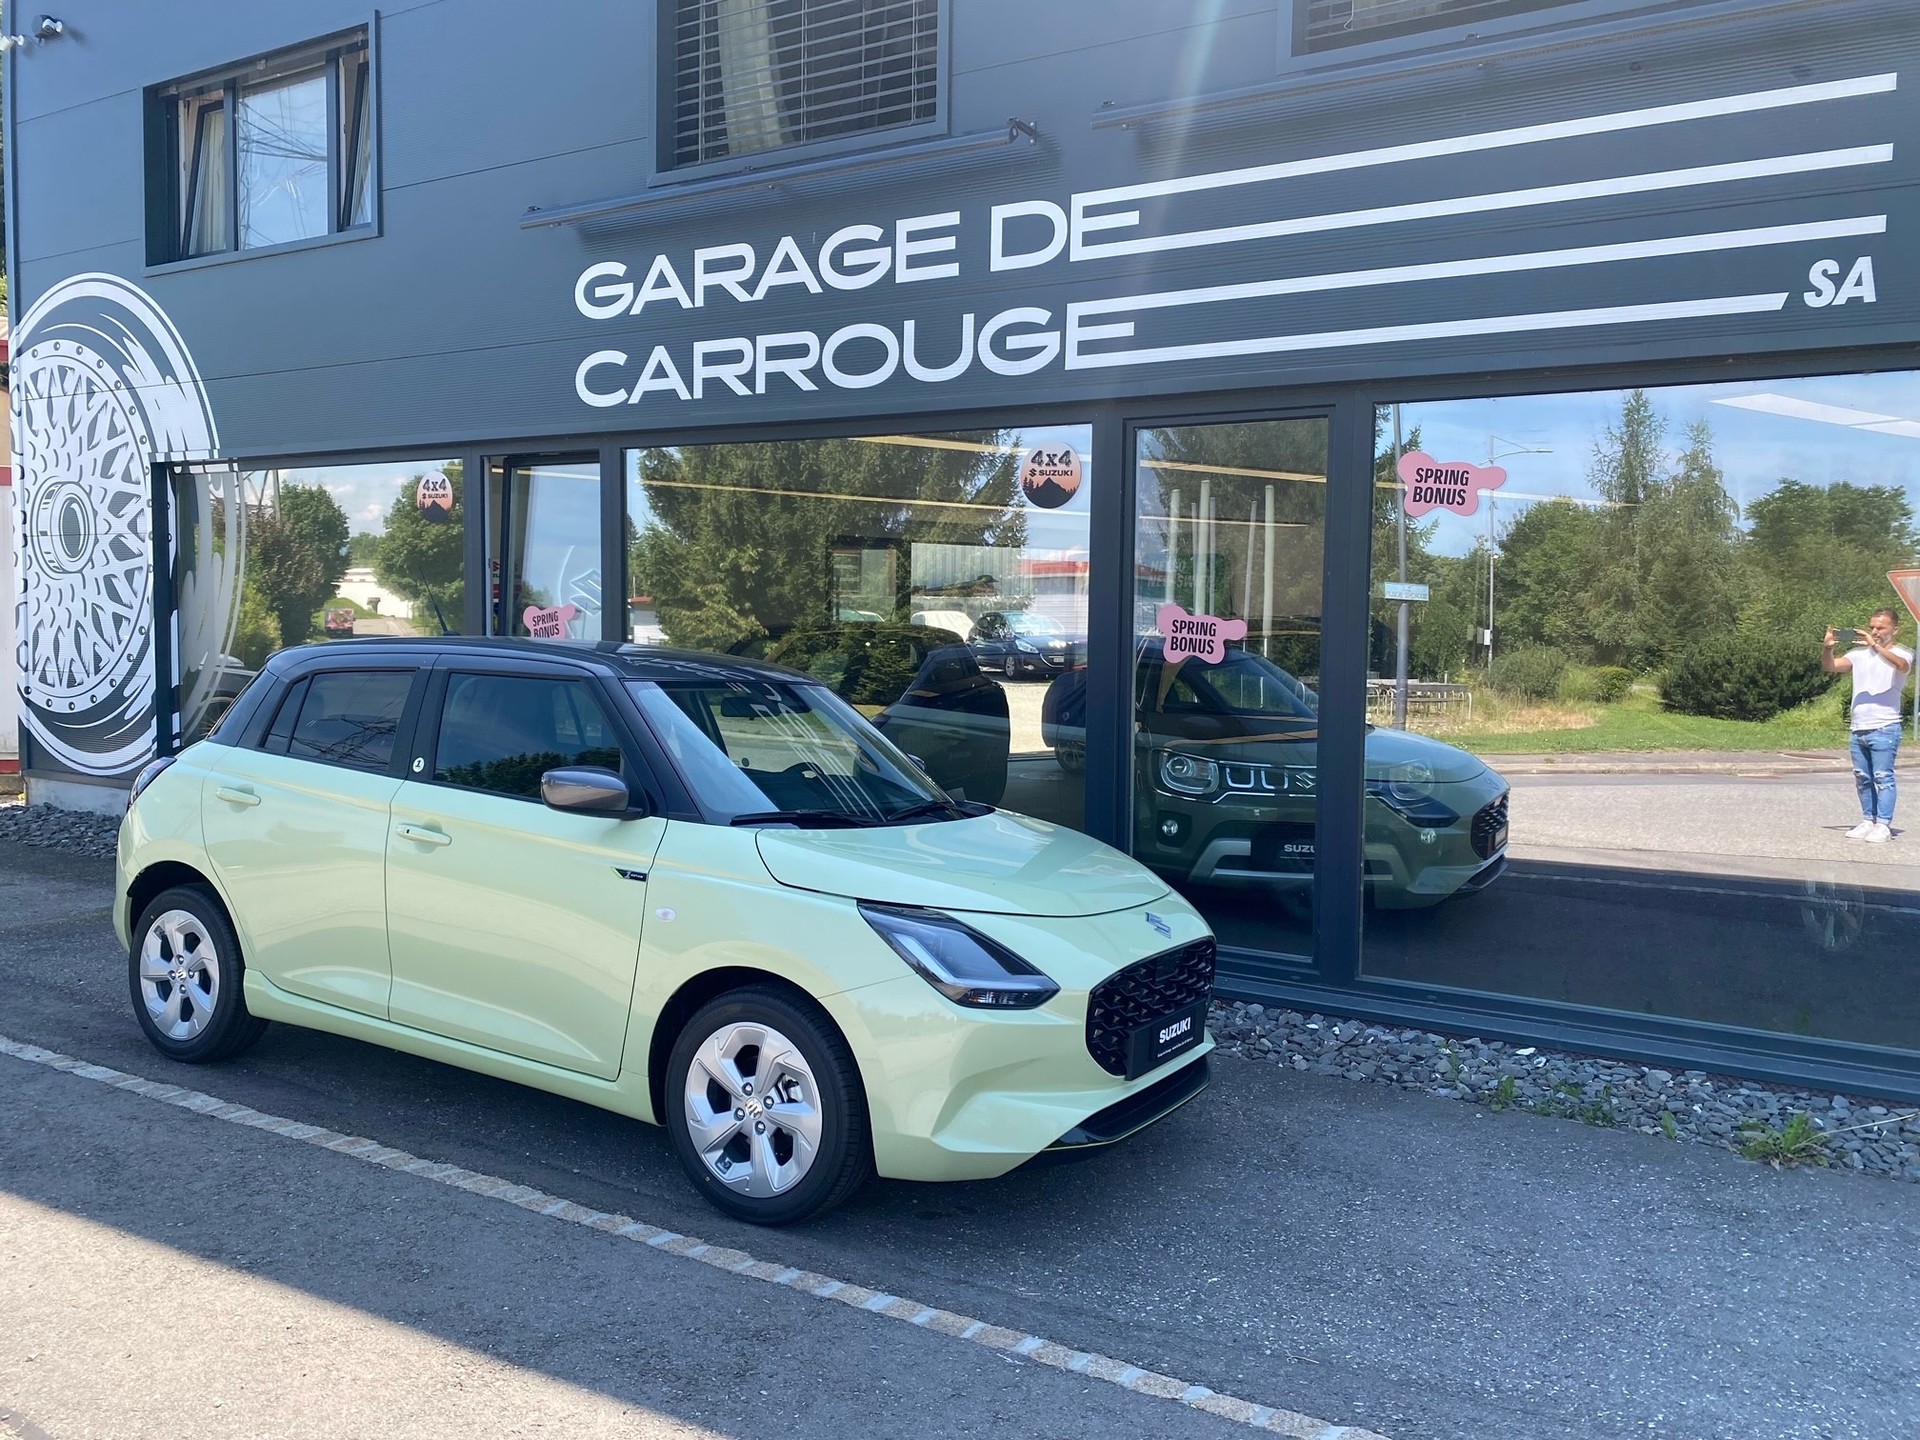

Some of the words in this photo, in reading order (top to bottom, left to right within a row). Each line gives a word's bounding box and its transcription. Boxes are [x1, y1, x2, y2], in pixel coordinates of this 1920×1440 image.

[573, 210, 961, 320] GARAGE
[989, 184, 1141, 273] DE
[1803, 255, 1877, 308] SA
[574, 296, 1136, 408] CARROUGE
[1030, 449, 1072, 468] 4x4
[1038, 469, 1073, 477] SUZUKI
[1414, 467, 1470, 486] SPRING
[422, 478, 447, 492] 4x4
[1412, 485, 1467, 506] BONUS
[532, 610, 559, 627] SPRING
[1171, 619, 1217, 637] SPRING
[533, 623, 560, 638] BONUS
[1170, 636, 1215, 655] BONUS
[1158, 1016, 1192, 1044] SUZUKI
